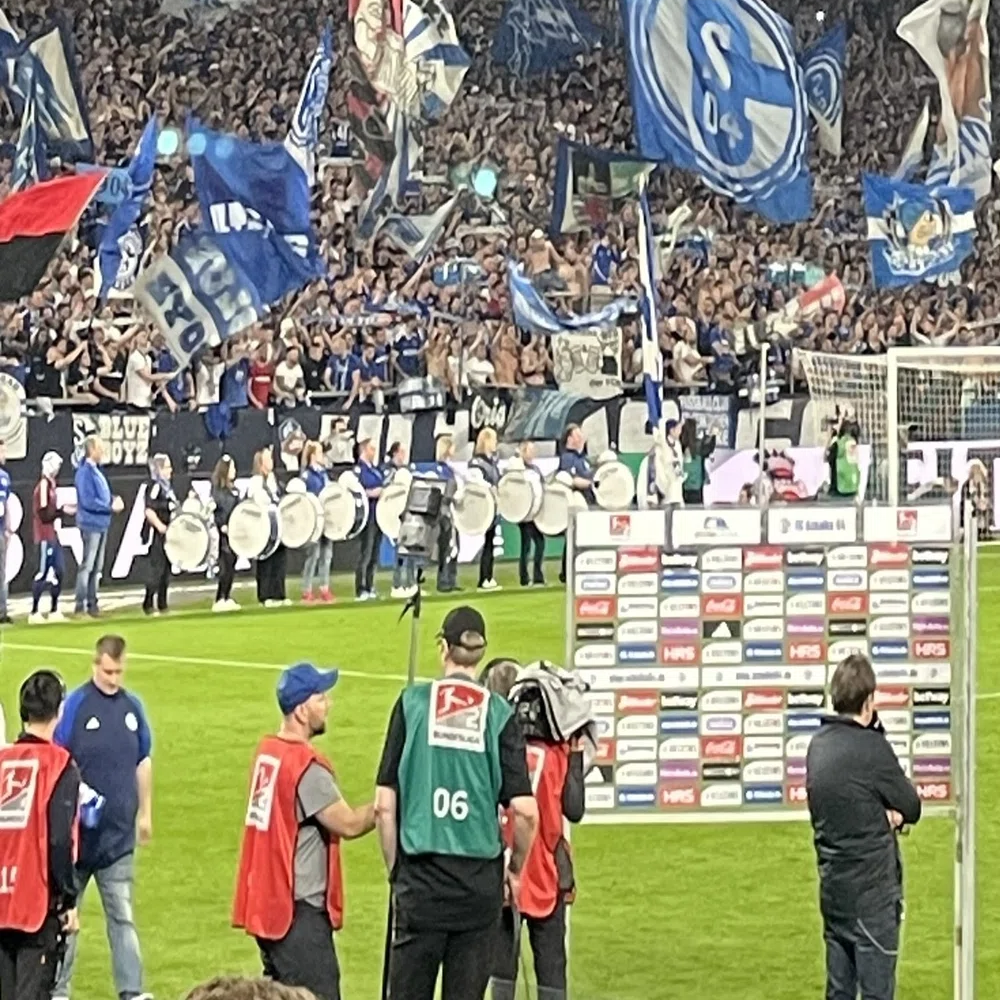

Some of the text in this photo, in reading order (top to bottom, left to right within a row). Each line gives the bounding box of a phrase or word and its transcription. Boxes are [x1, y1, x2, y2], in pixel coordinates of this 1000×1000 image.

[663, 646, 696, 661] HRS
[789, 644, 822, 659] HRS
[915, 642, 948, 657] HRS
[663, 788, 696, 804] HRS
[917, 784, 948, 799] HRS
[432, 787, 469, 821] 06
